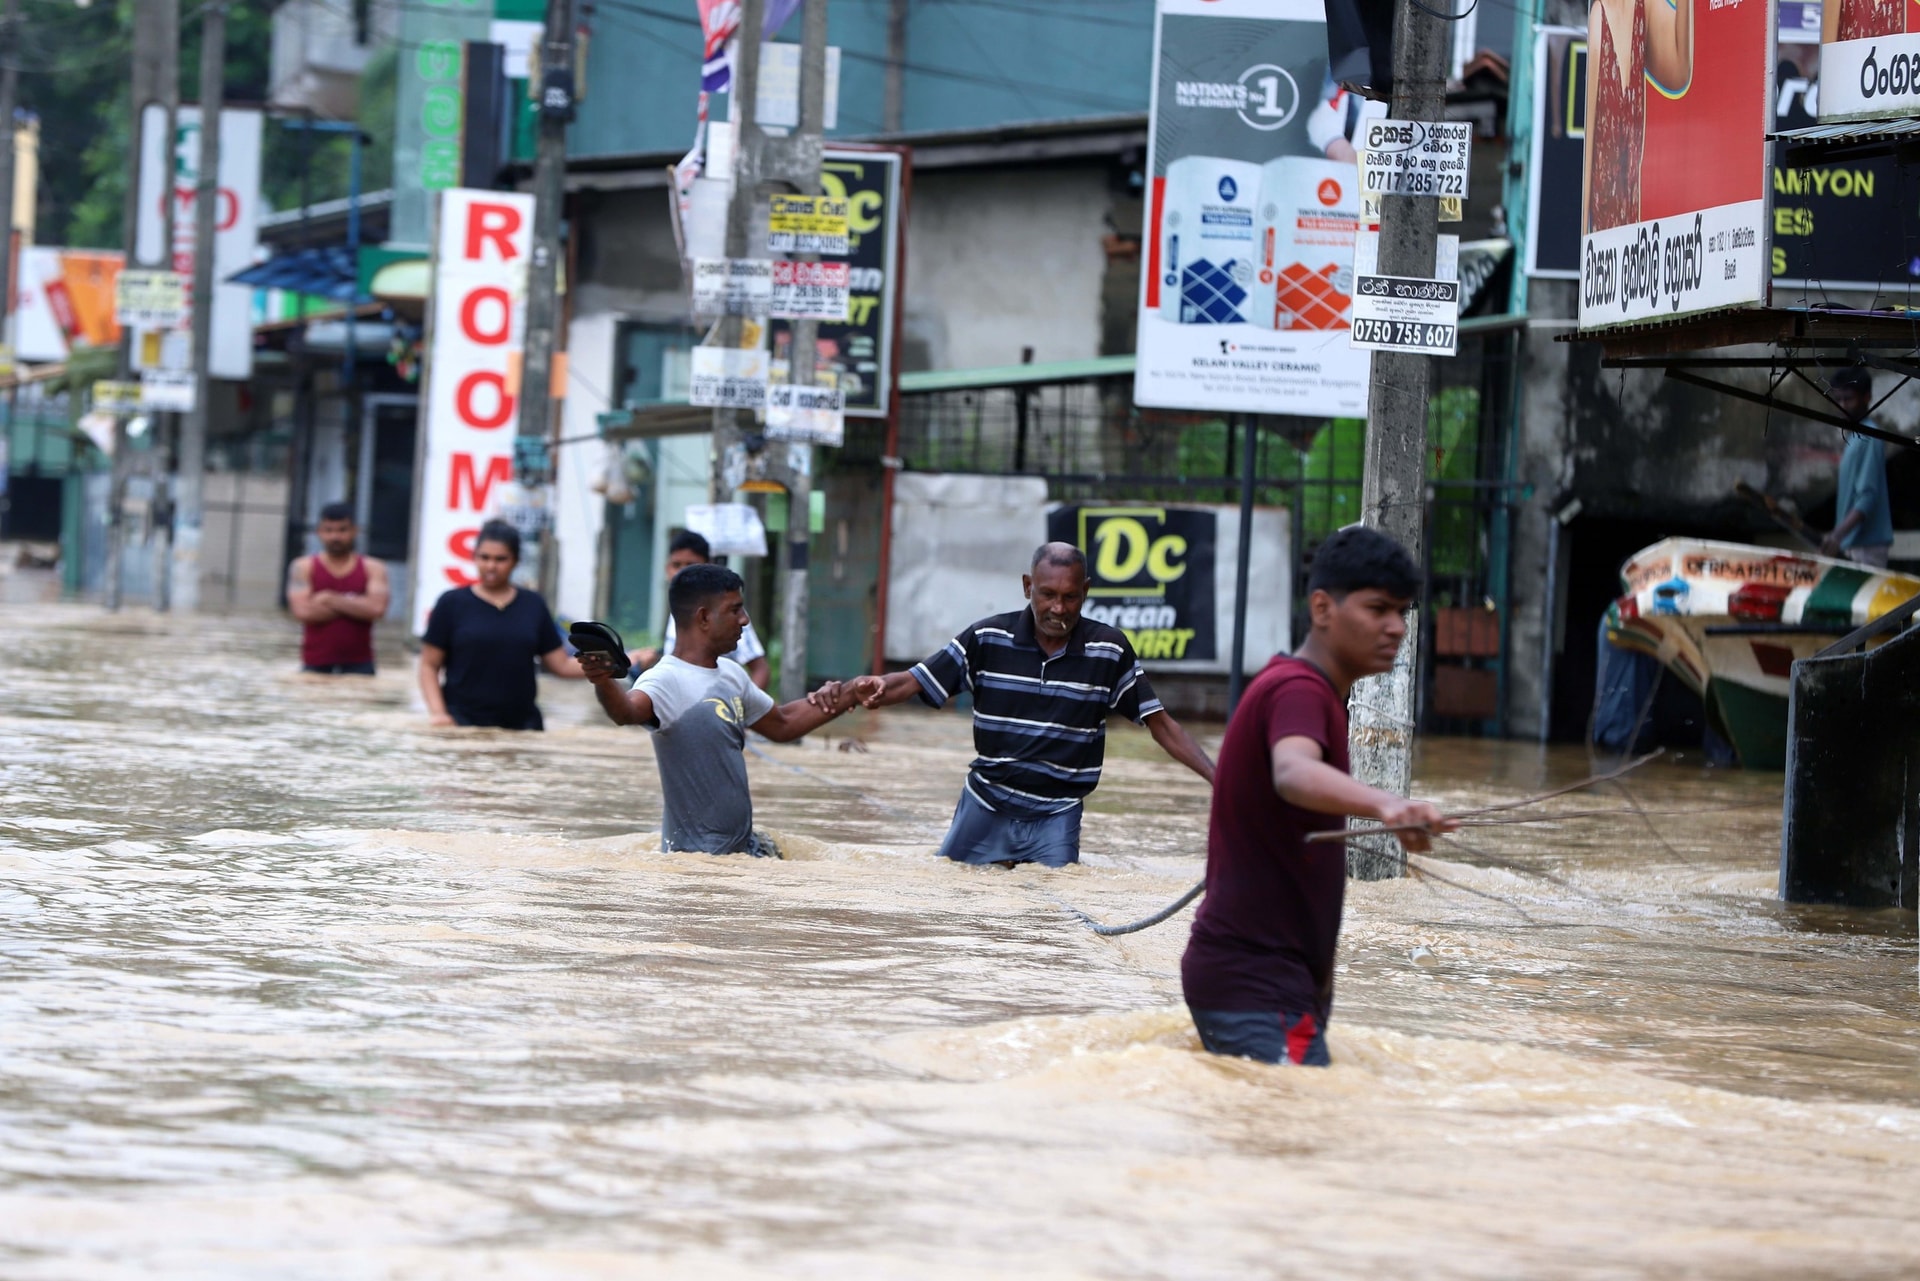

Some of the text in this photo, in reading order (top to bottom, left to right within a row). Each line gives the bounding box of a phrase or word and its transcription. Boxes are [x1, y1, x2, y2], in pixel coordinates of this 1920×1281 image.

[1176, 81, 1247, 98] NATION'S
[1256, 76, 1284, 117] 1
[1369, 122, 1414, 148] උකස්
[1395, 153, 1417, 170] මිලට
[1367, 170, 1462, 194] 0717 285 722
[1362, 279, 1390, 296] රන්
[1355, 320, 1453, 347] 0750 755 607
[1192, 357, 1321, 374] KELANI VALLEY CERAMIC
[442, 202, 523, 586] ROOMS
[1094, 517, 1187, 582] Dc
